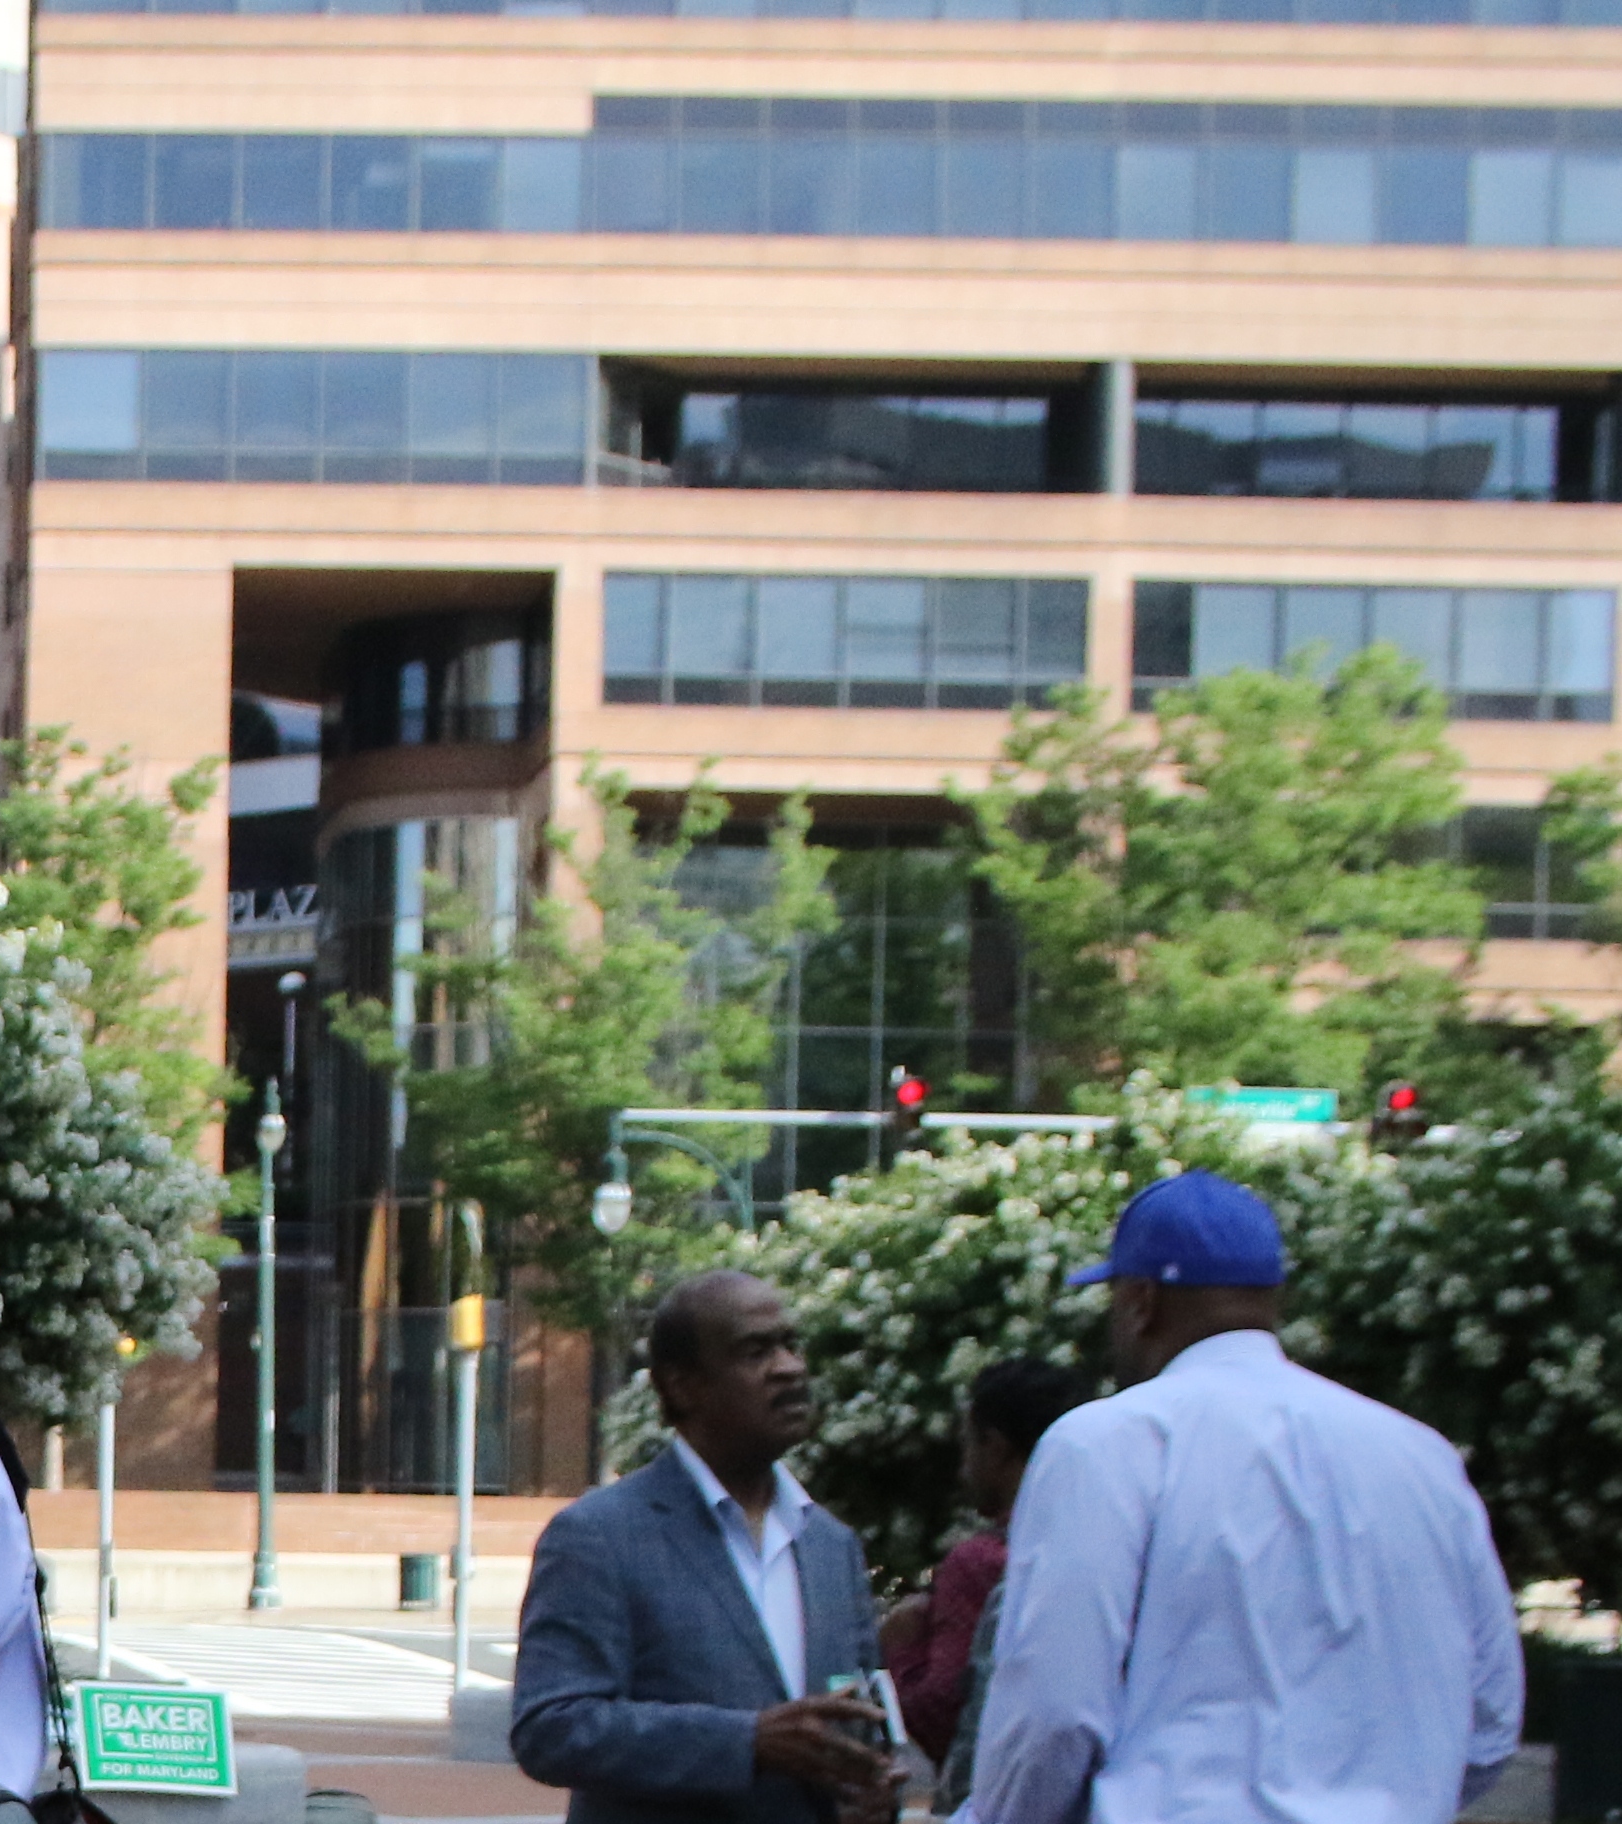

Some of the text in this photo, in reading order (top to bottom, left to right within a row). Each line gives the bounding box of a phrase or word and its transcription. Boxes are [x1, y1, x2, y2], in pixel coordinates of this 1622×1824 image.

[101, 1702, 208, 1732] BAKER
[140, 1732, 208, 1751] EMBRY
[100, 1762, 219, 1781] FOR MARYLAND
